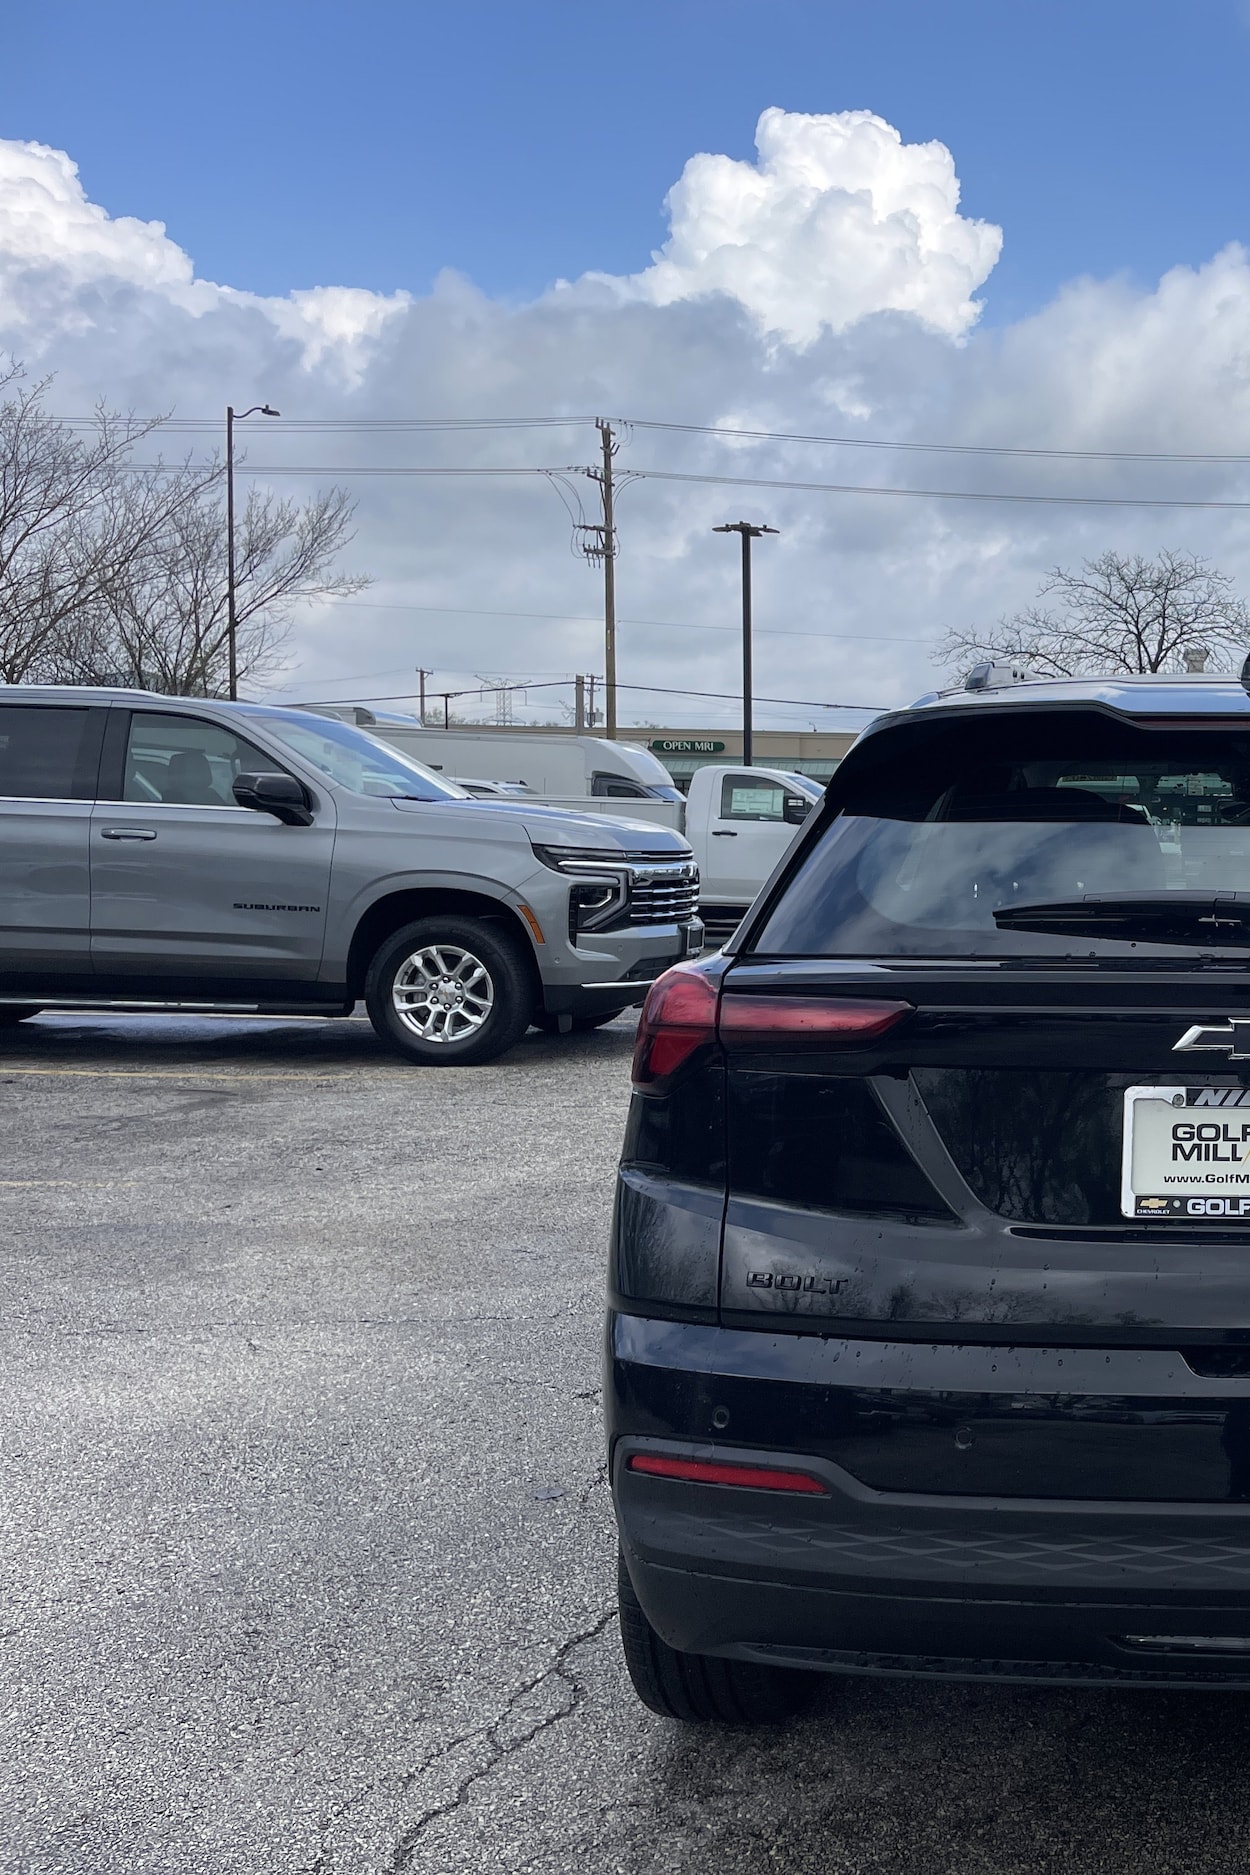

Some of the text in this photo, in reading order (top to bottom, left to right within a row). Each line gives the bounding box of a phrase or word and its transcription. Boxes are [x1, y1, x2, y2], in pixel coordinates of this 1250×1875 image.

[663, 741, 714, 751] OPEN MRI
[232, 902, 321, 913] SUBURBAN
[1171, 1143, 1243, 1161] MILL
[746, 1271, 849, 1294] BOLT
